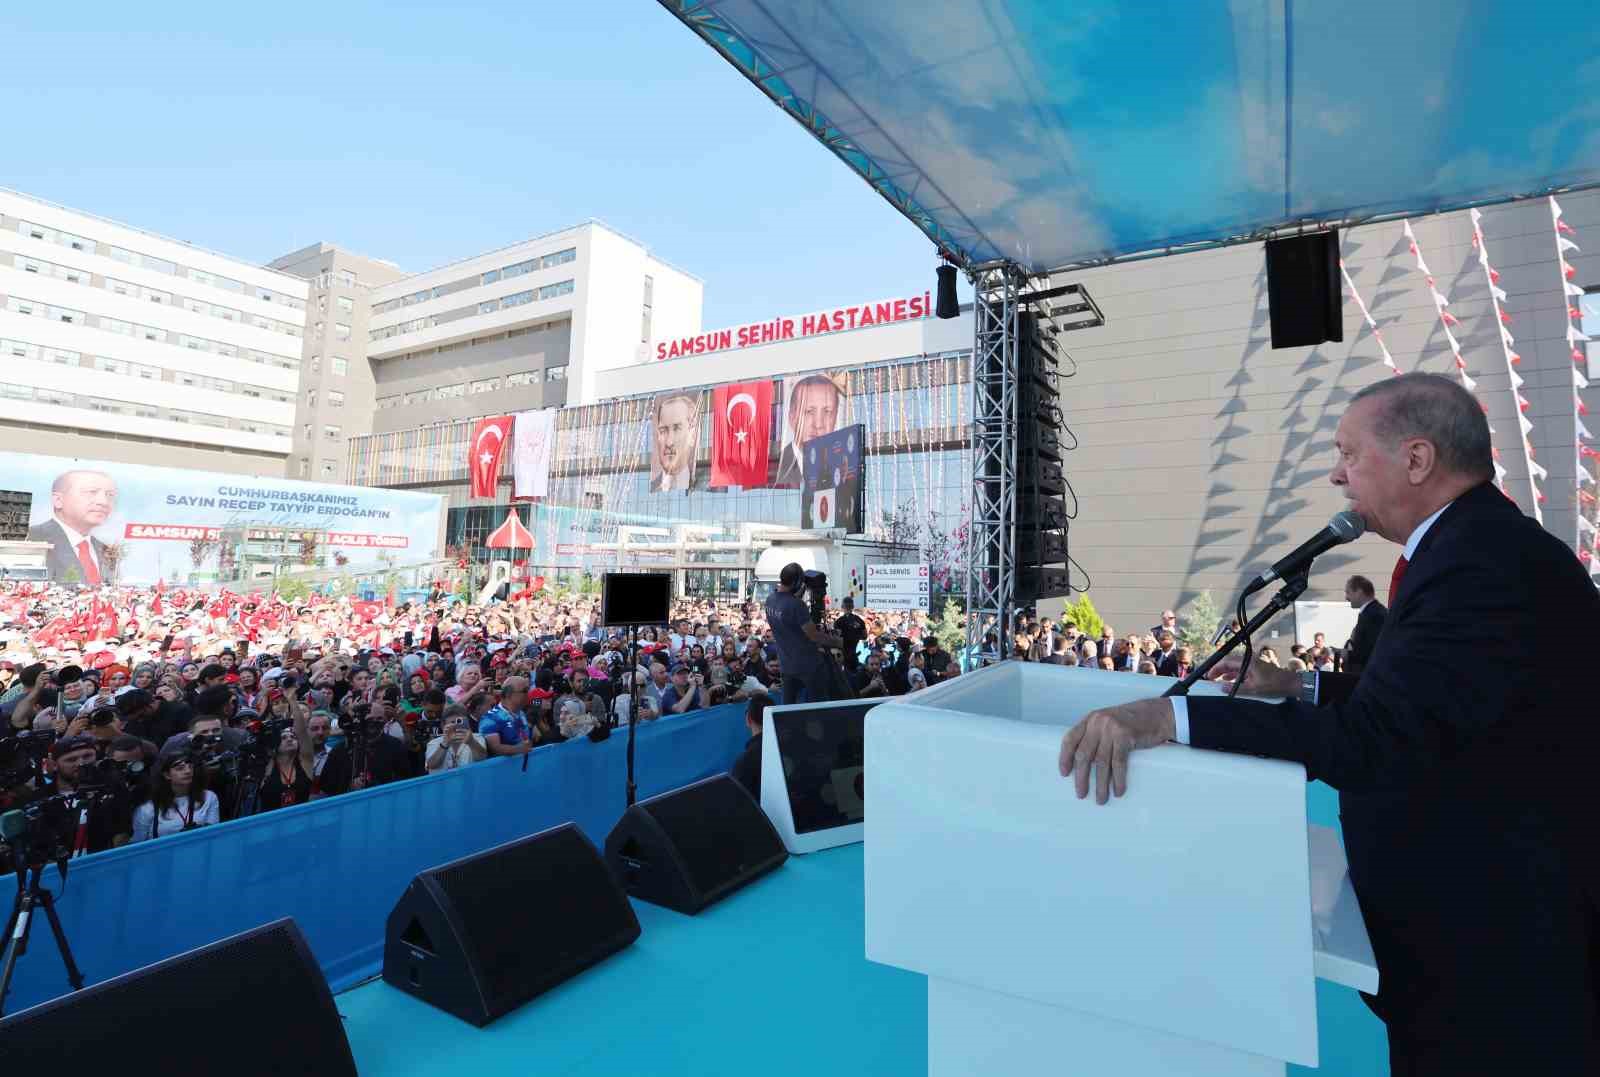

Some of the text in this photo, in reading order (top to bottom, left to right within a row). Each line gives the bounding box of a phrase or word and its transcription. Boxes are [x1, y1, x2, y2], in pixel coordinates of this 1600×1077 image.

[656, 291, 930, 360] SAMSUN ŞEHİR HASTANESİ
[166, 494, 215, 510] SAYIN
[218, 499, 267, 512] RECEP
[270, 501, 314, 515] TAYYİP
[217, 485, 359, 506] CUMHURBAŞKANIMIZ
[130, 525, 204, 540] SAMSUN
